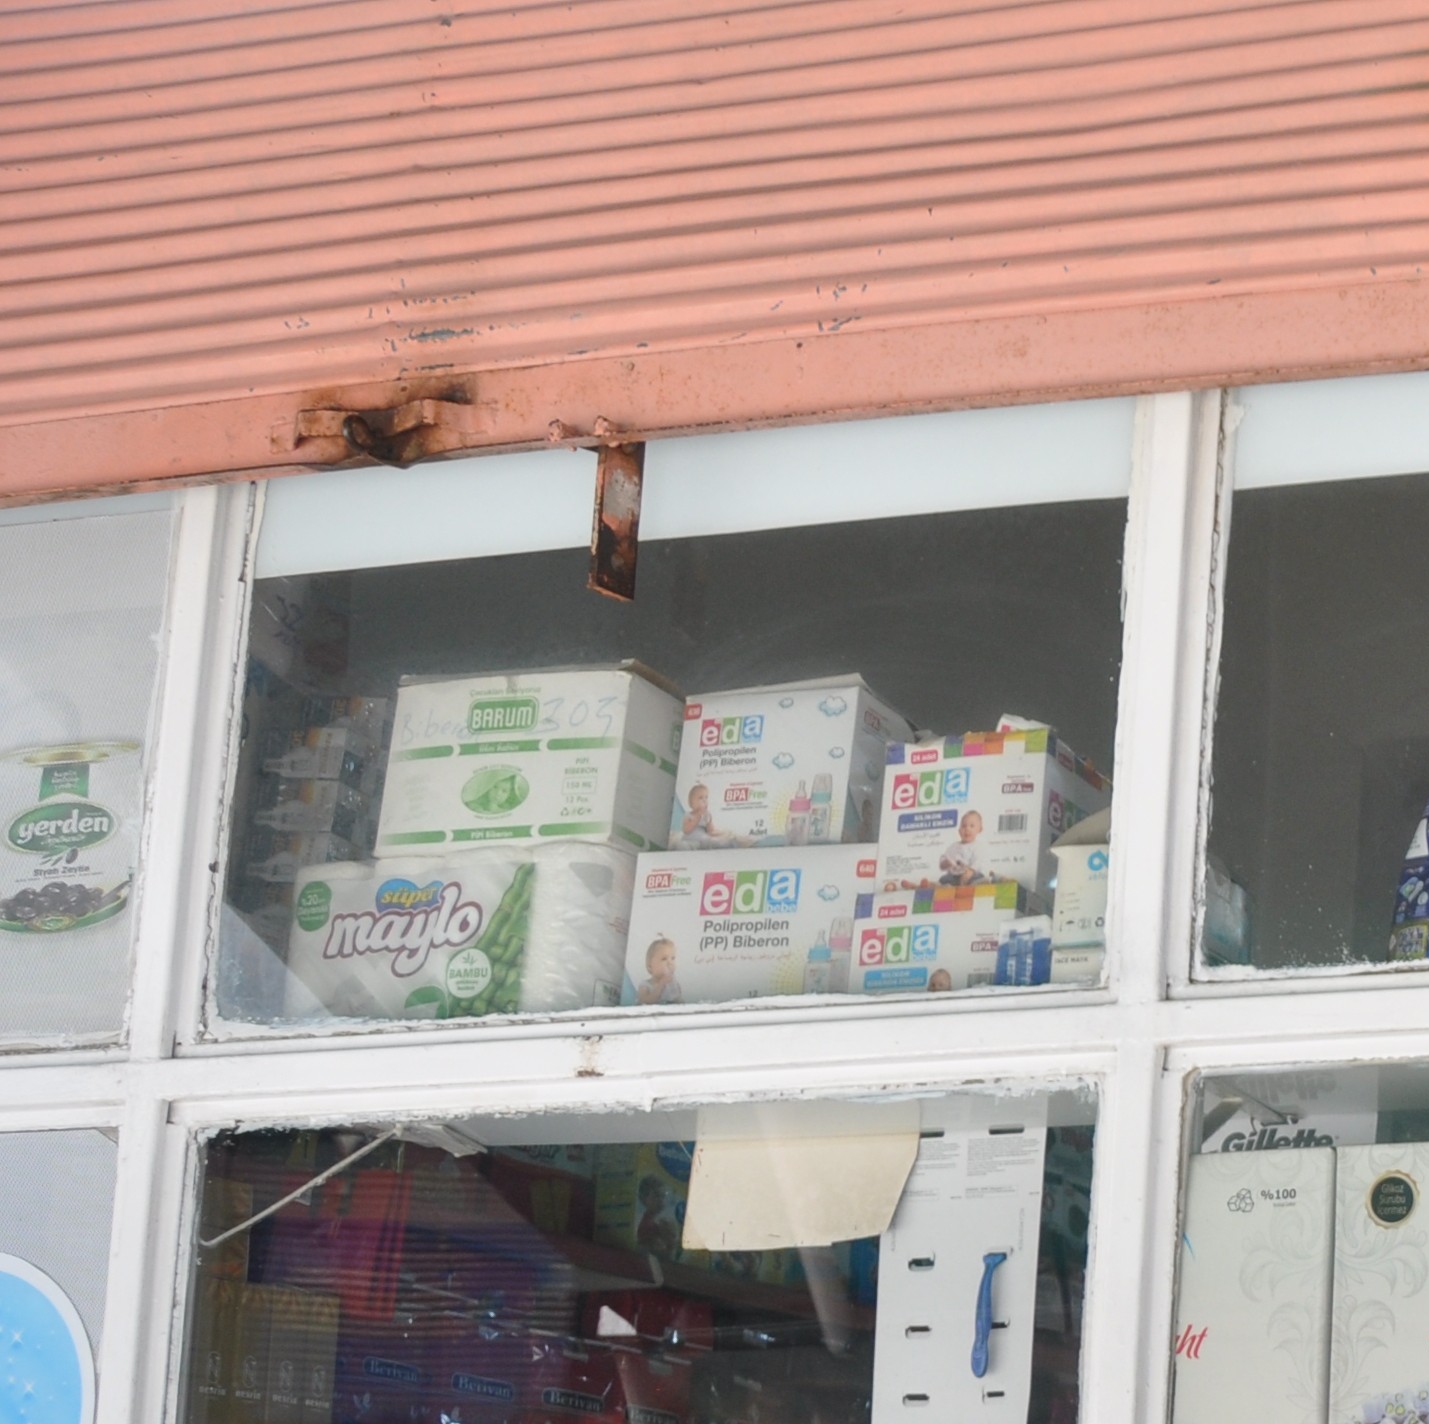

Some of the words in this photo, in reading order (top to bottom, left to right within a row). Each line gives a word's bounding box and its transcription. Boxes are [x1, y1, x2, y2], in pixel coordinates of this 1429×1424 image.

[472, 705, 533, 730] BARUM
[701, 715, 763, 746] eda
[702, 746, 757, 758] Polipropilen
[721, 757, 757, 767] Biberon
[726, 788, 746, 802] BPA
[894, 768, 968, 808] eda
[17, 808, 109, 845] yerden
[648, 874, 669, 888] BPA
[671, 875, 691, 886] Free
[702, 870, 798, 914] eda
[323, 881, 483, 978] maylo
[704, 919, 790, 934] Polipropilen
[699, 936, 729, 952] (PP)
[733, 935, 790, 949] Biberon
[861, 925, 937, 963] eda
[448, 966, 488, 980] BAMBU
[1220, 1126, 1334, 1153] Gillette
[1260, 1188, 1297, 1200] %100
